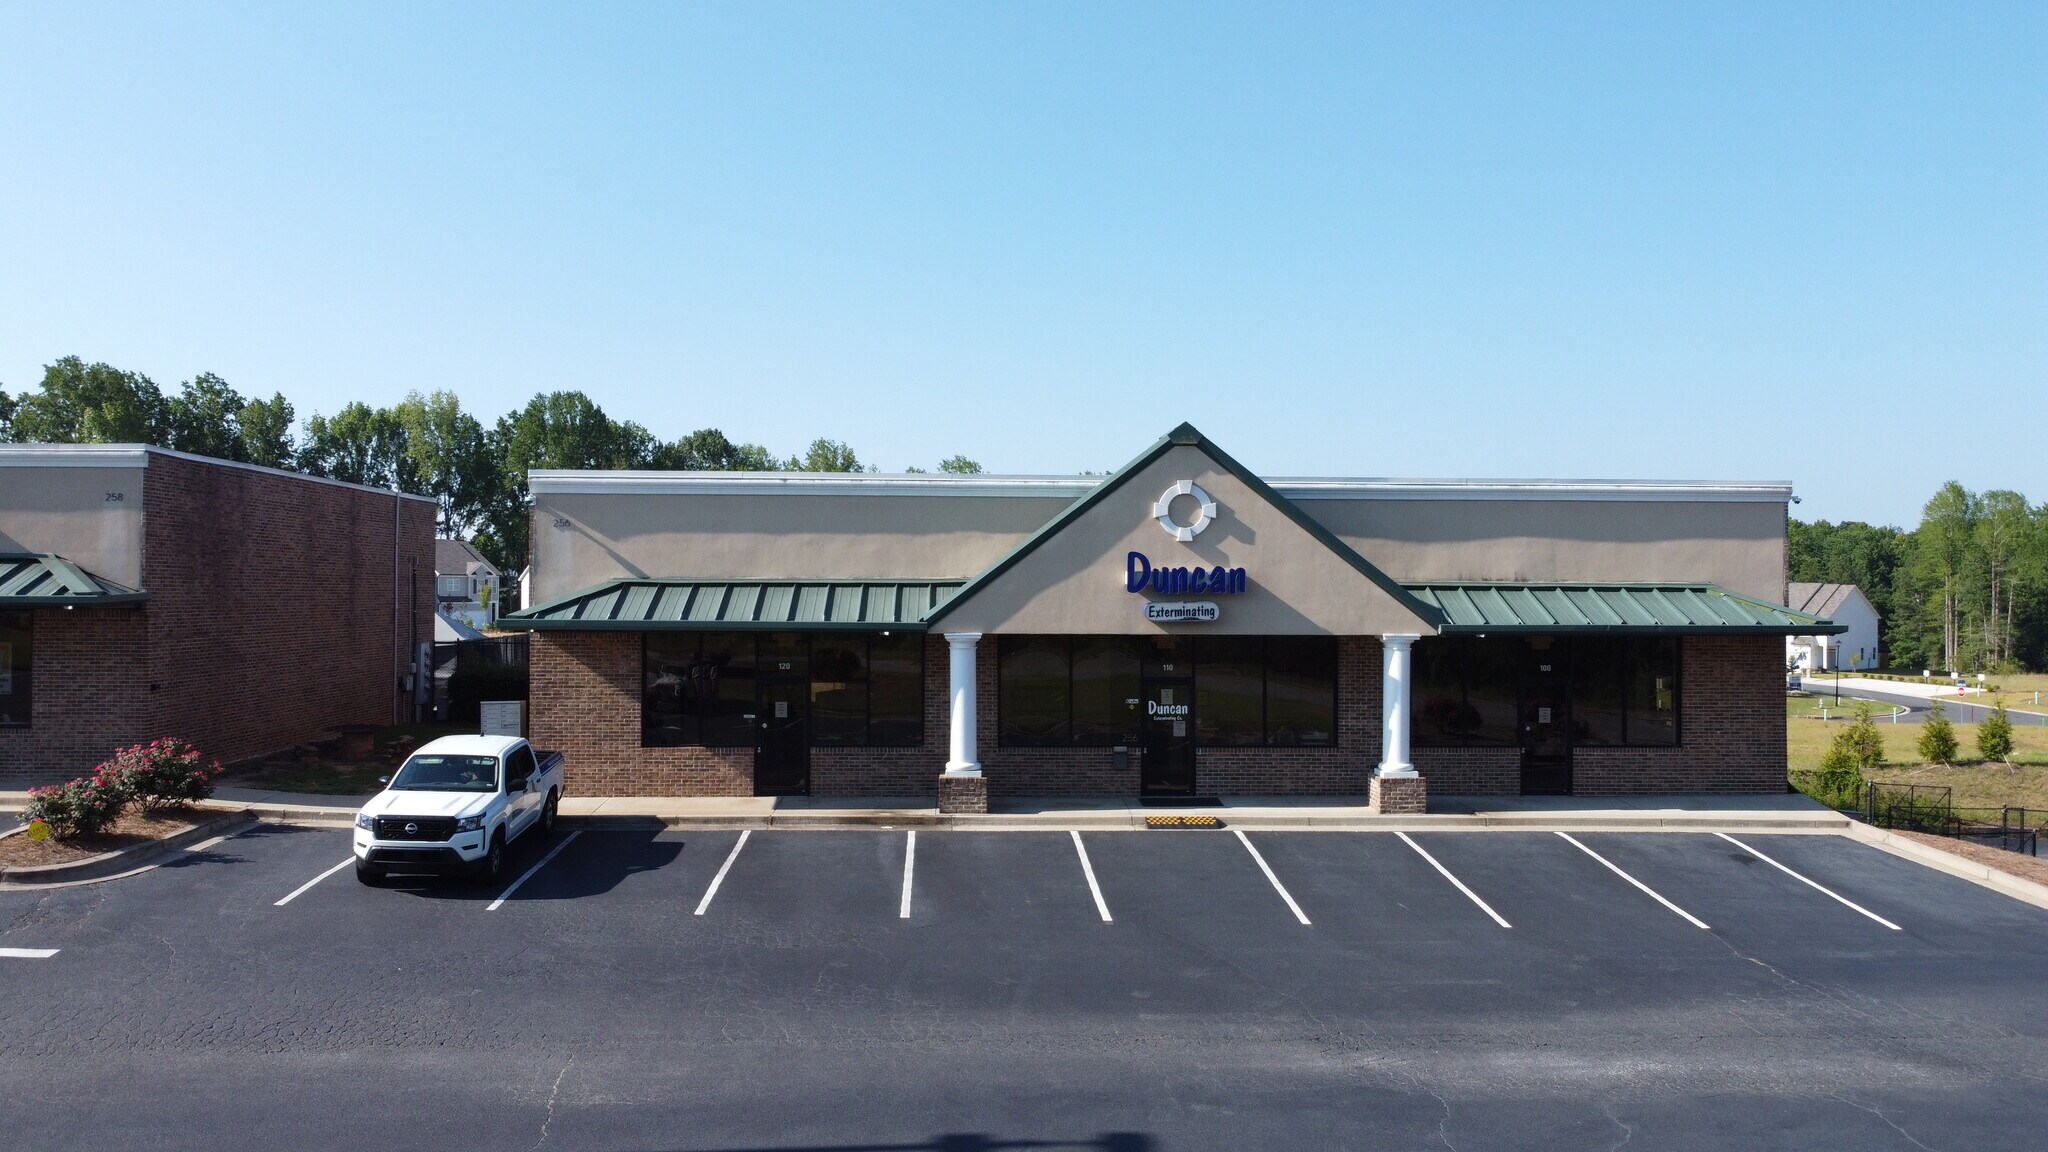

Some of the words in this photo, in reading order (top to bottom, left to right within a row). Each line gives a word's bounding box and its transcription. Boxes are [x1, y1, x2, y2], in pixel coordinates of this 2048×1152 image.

[105, 492, 123, 501] 258
[553, 518, 571, 527] 256
[1126, 550, 1247, 594] Duncan
[1148, 605, 1215, 619] Exterminating
[778, 662, 791, 670] 120
[1540, 664, 1551, 672] 100
[1148, 700, 1188, 715] Duncan
